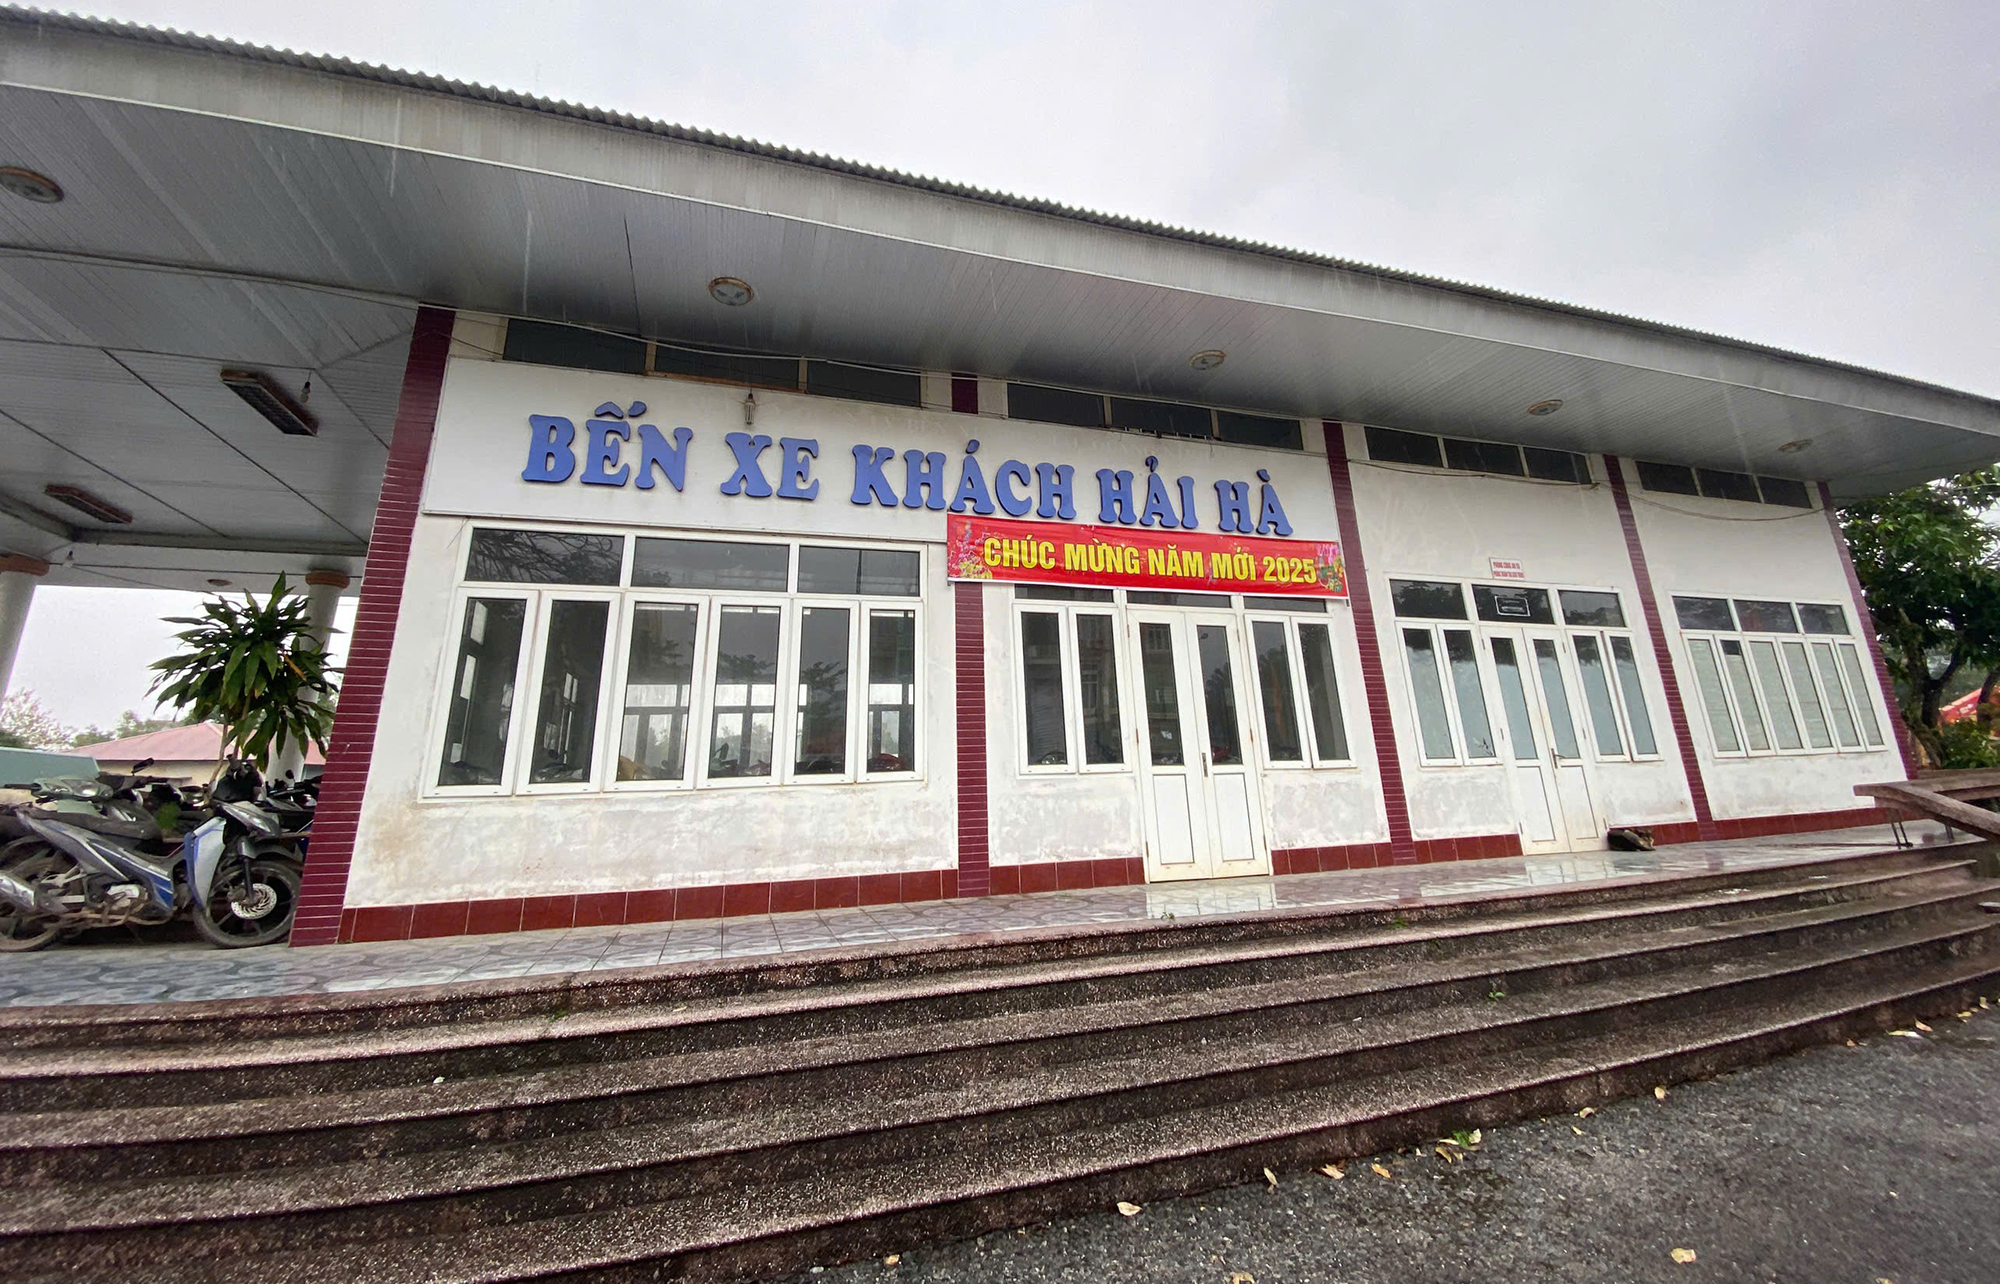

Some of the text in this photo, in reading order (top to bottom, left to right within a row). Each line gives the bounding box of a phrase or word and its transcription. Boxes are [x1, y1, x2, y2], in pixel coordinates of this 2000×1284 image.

[521, 401, 1294, 536] BẾN XE KHÁCH HẢI HÀ
[984, 535, 1317, 584] CHÚC MỪNG NĂM MỚI 2025
